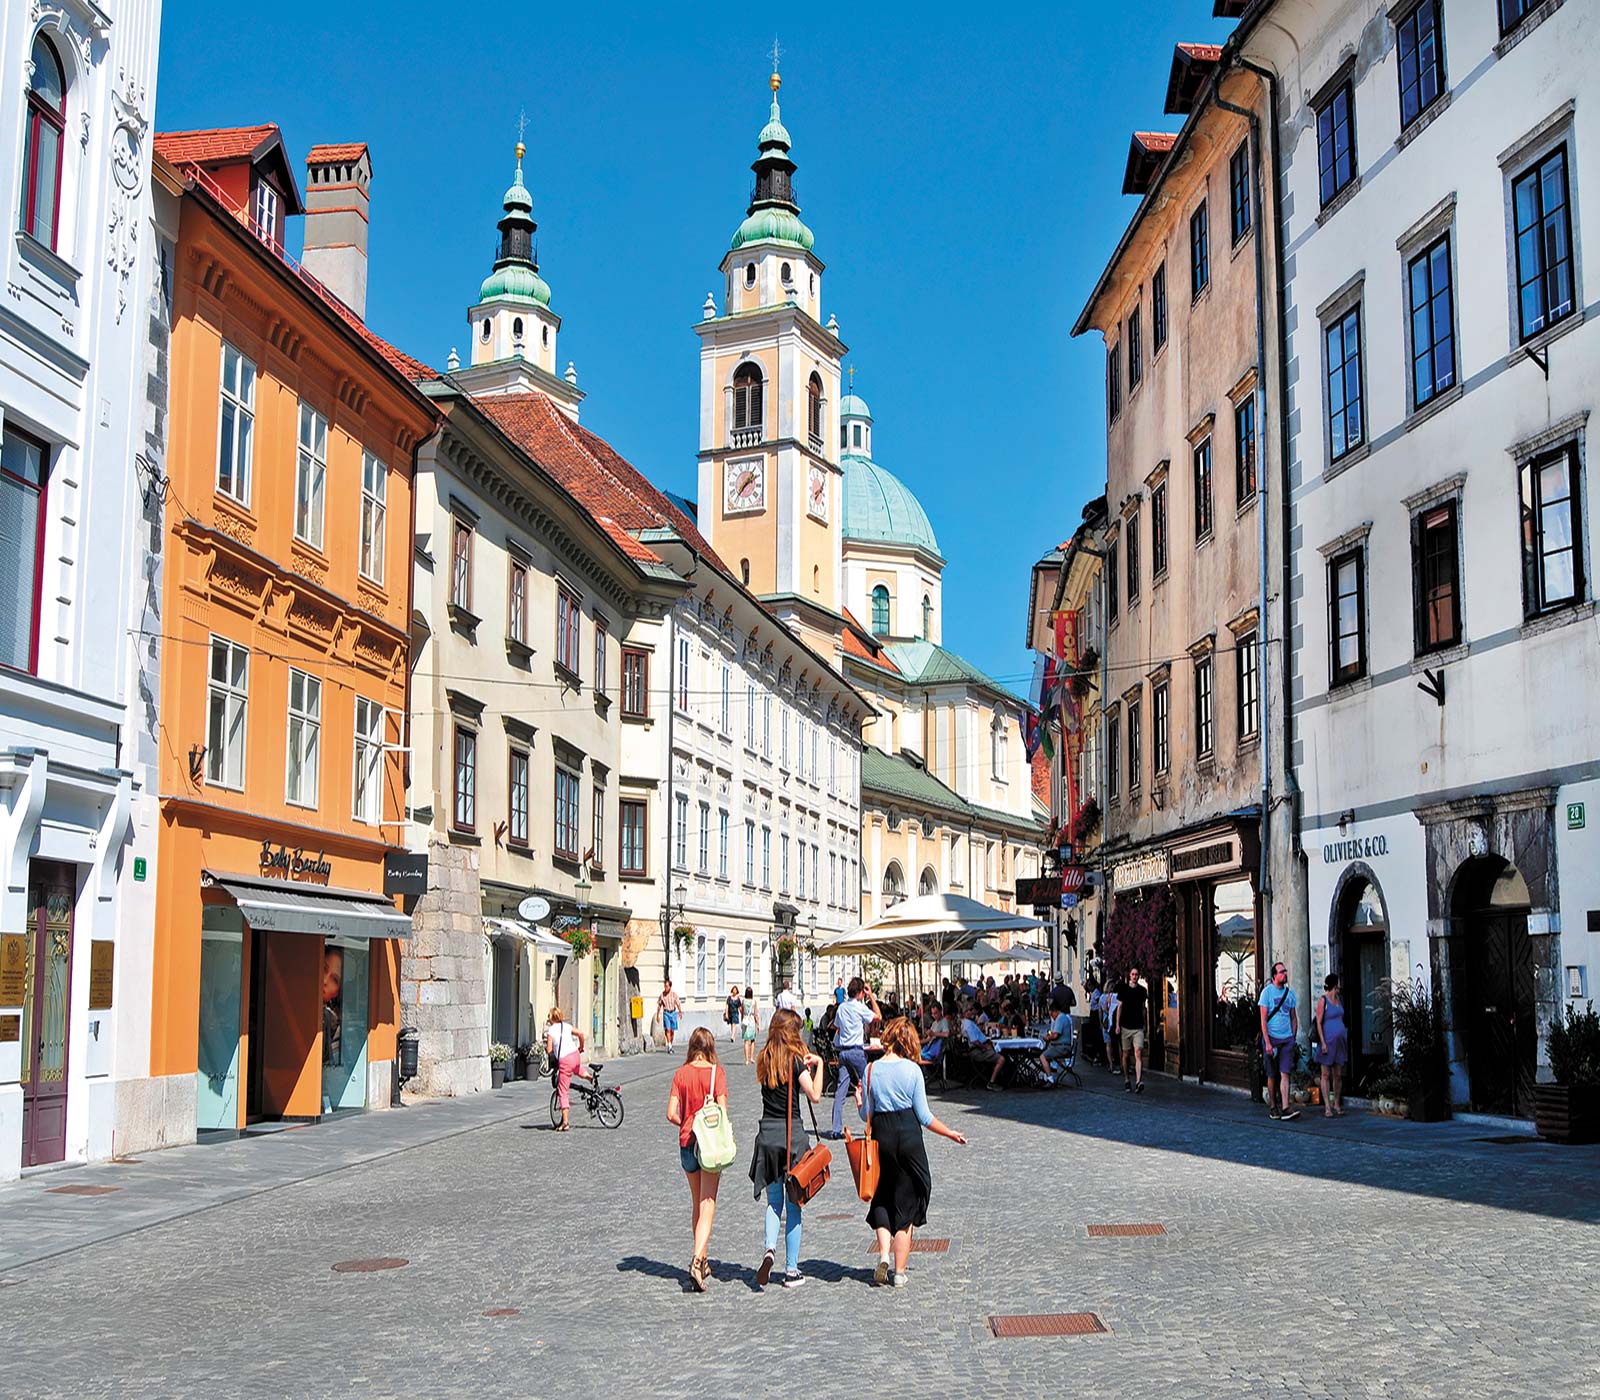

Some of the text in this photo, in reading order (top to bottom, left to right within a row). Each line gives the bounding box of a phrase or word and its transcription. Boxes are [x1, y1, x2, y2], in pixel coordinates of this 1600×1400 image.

[1570, 806, 1579, 819] 20
[1323, 838, 1363, 864] OLIVIERS
[260, 839, 331, 887] Betty Barclay
[1064, 869, 1084, 890] illy
